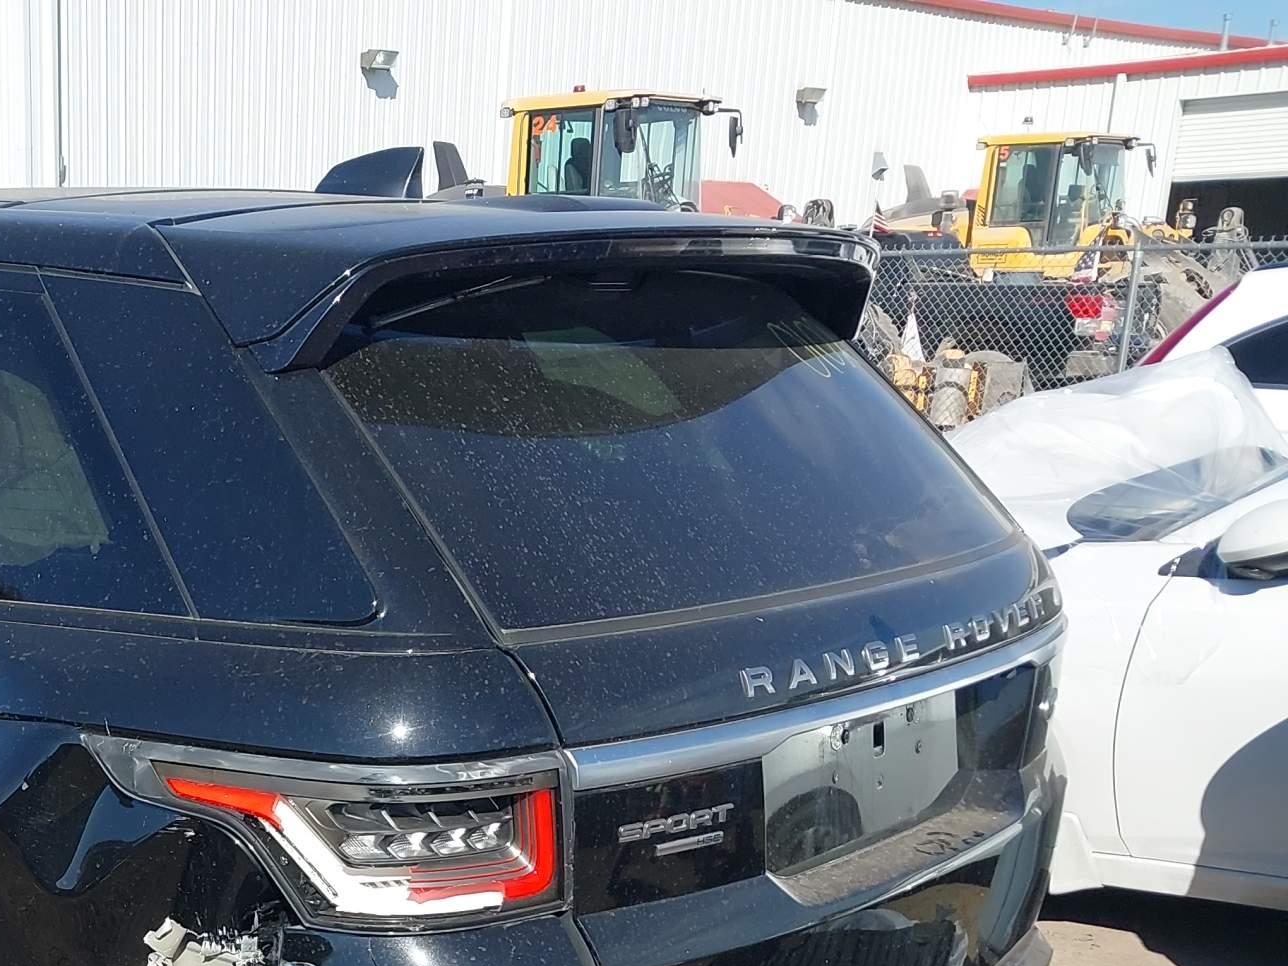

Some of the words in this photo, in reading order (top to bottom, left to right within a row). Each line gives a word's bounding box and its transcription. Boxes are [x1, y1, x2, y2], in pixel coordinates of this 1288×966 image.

[532, 113, 559, 136] 24
[739, 633, 920, 698] RANGE
[942, 592, 1046, 650] ROVER
[617, 803, 734, 843] SPORT
